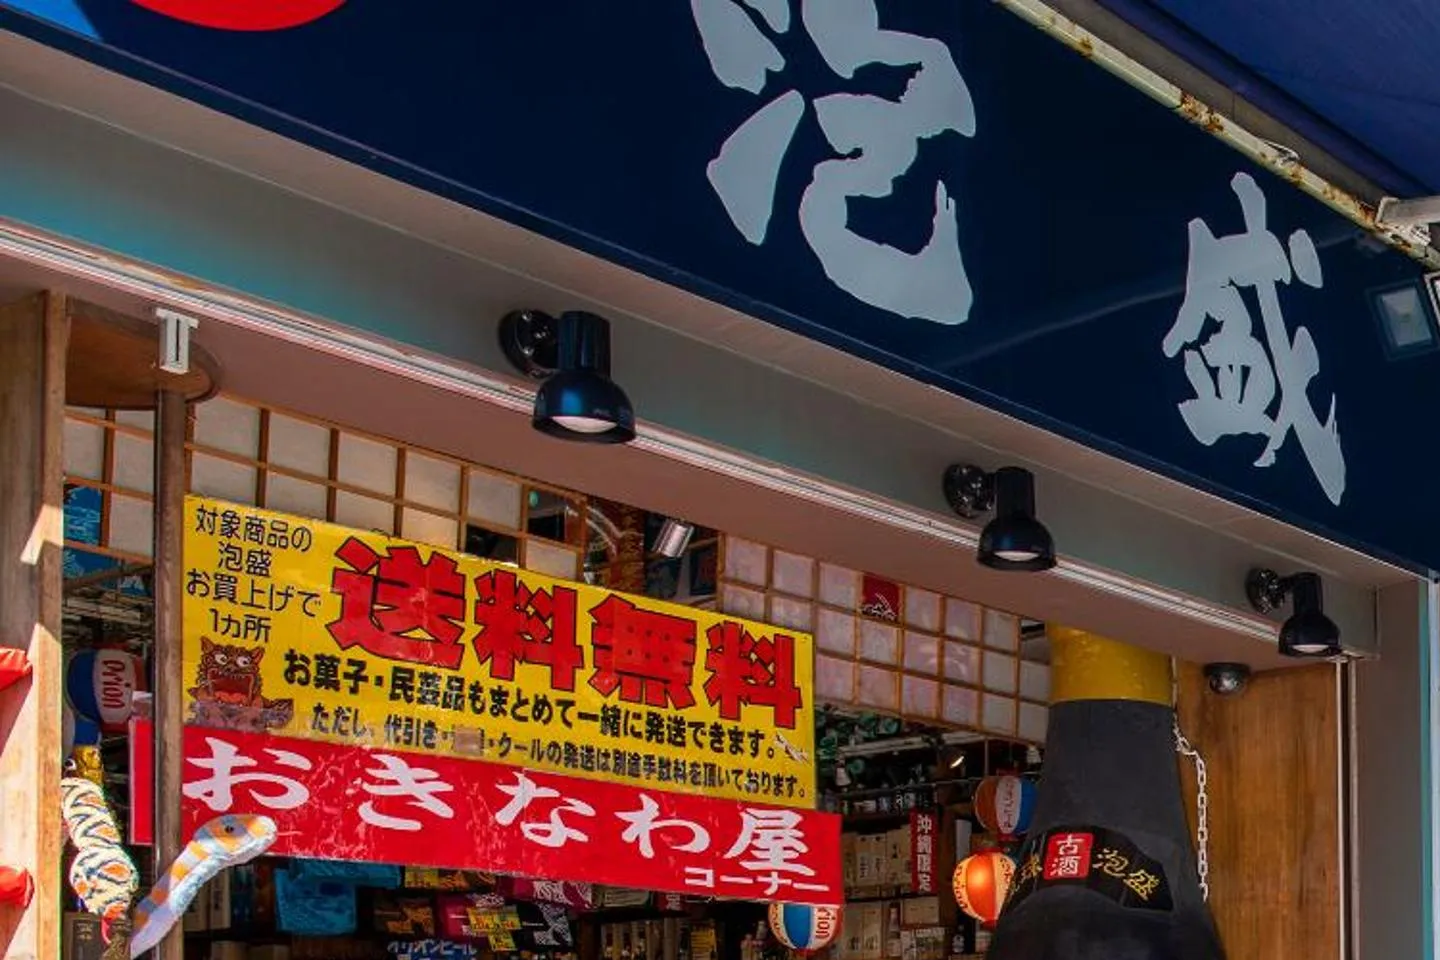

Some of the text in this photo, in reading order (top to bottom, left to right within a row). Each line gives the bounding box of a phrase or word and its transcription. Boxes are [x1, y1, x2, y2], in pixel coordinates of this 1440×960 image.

[195, 503, 313, 553] 対象商品の
[217, 540, 272, 578] 泡盛
[185, 567, 322, 619] お買上げで
[325, 536, 804, 731] 送料無料
[182, 736, 815, 876] おきなわ屋
[682, 864, 832, 897] コーナー
[1049, 834, 1086, 876] 古酒
[1093, 847, 1162, 901] 泡盛
